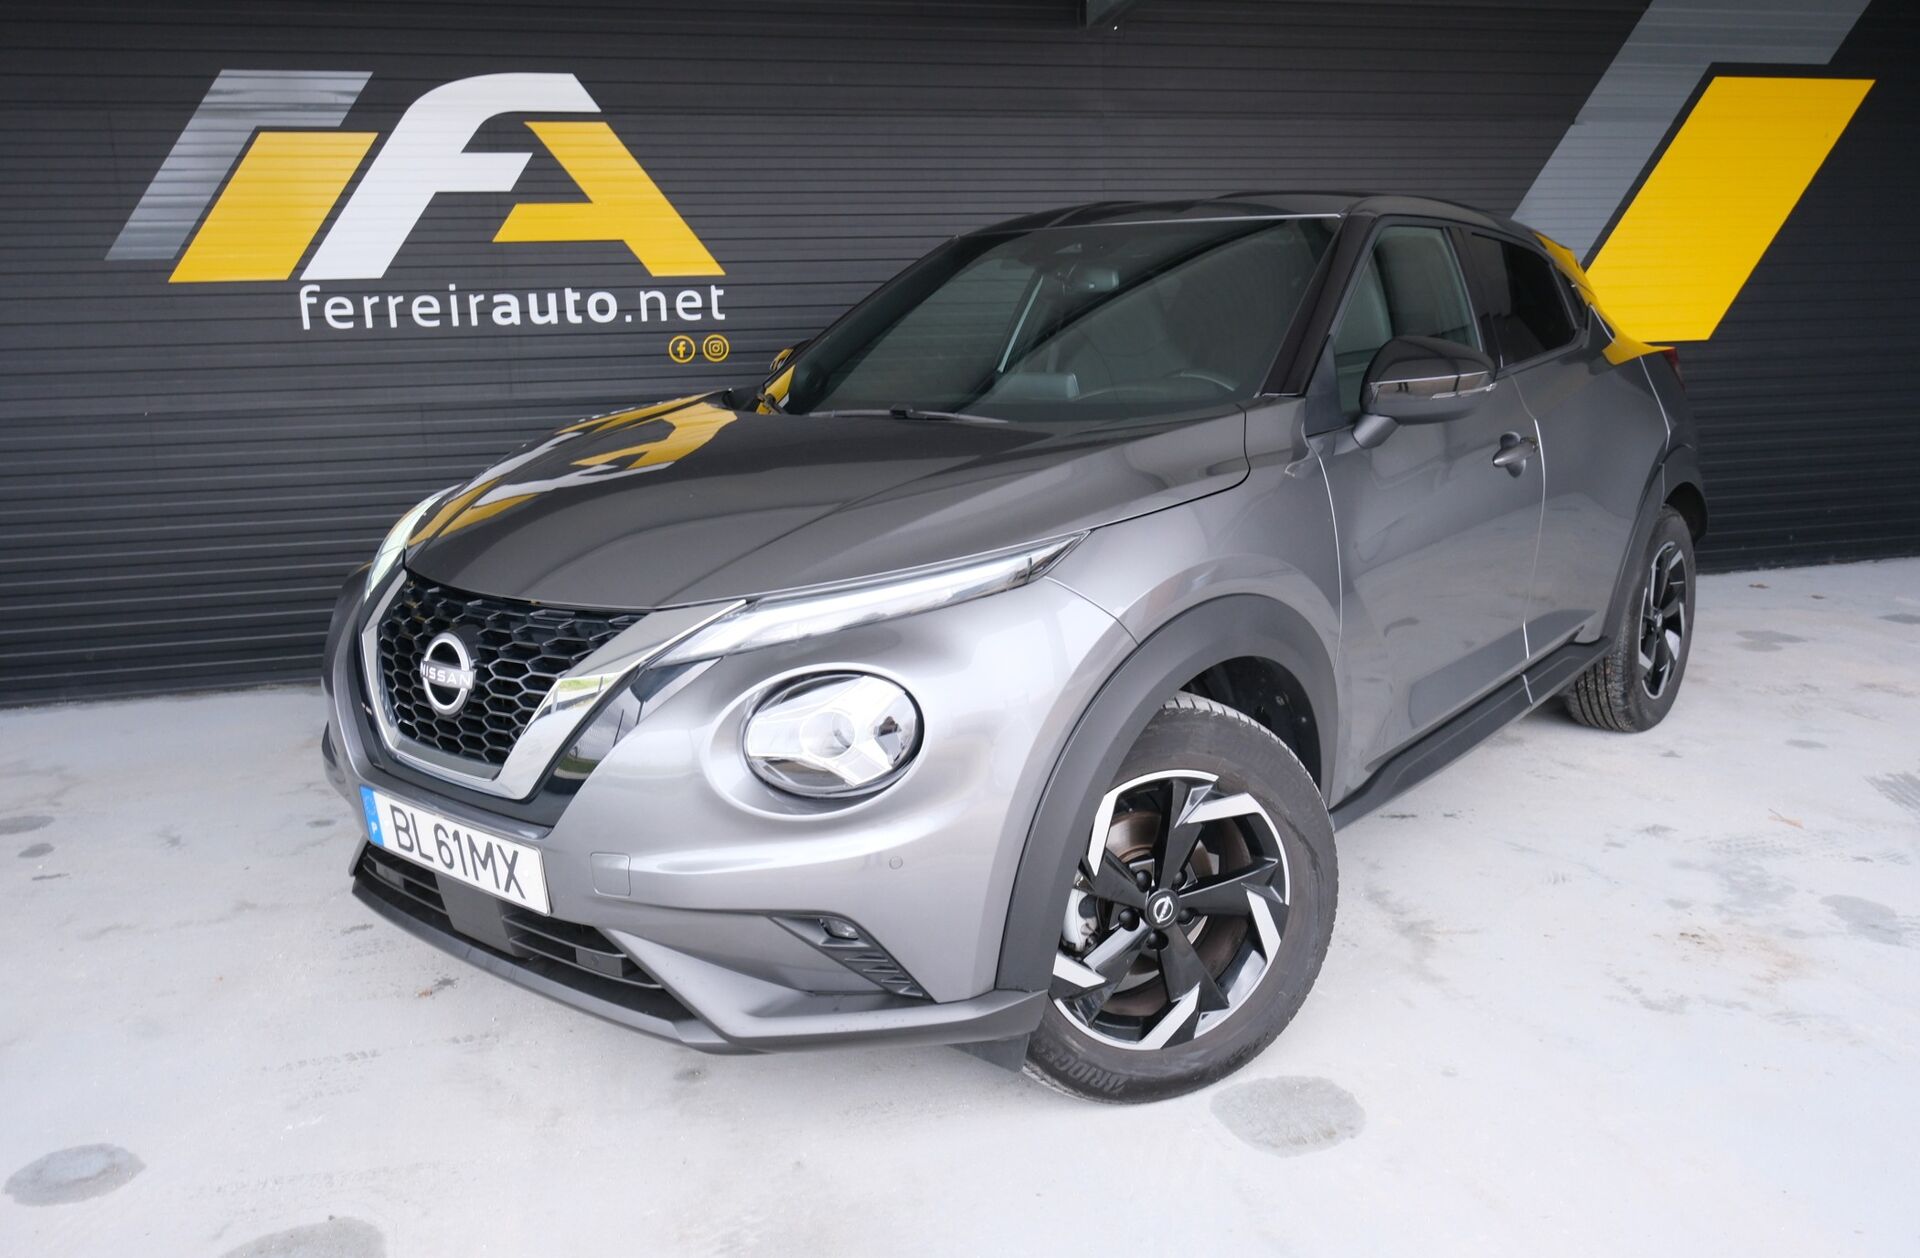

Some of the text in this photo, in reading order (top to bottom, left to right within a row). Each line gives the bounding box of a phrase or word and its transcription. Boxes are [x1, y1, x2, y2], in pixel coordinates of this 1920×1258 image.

[299, 283, 726, 330] ferreirauto.net
[420, 661, 471, 686] NISSAN
[389, 803, 527, 899] BL61MX
